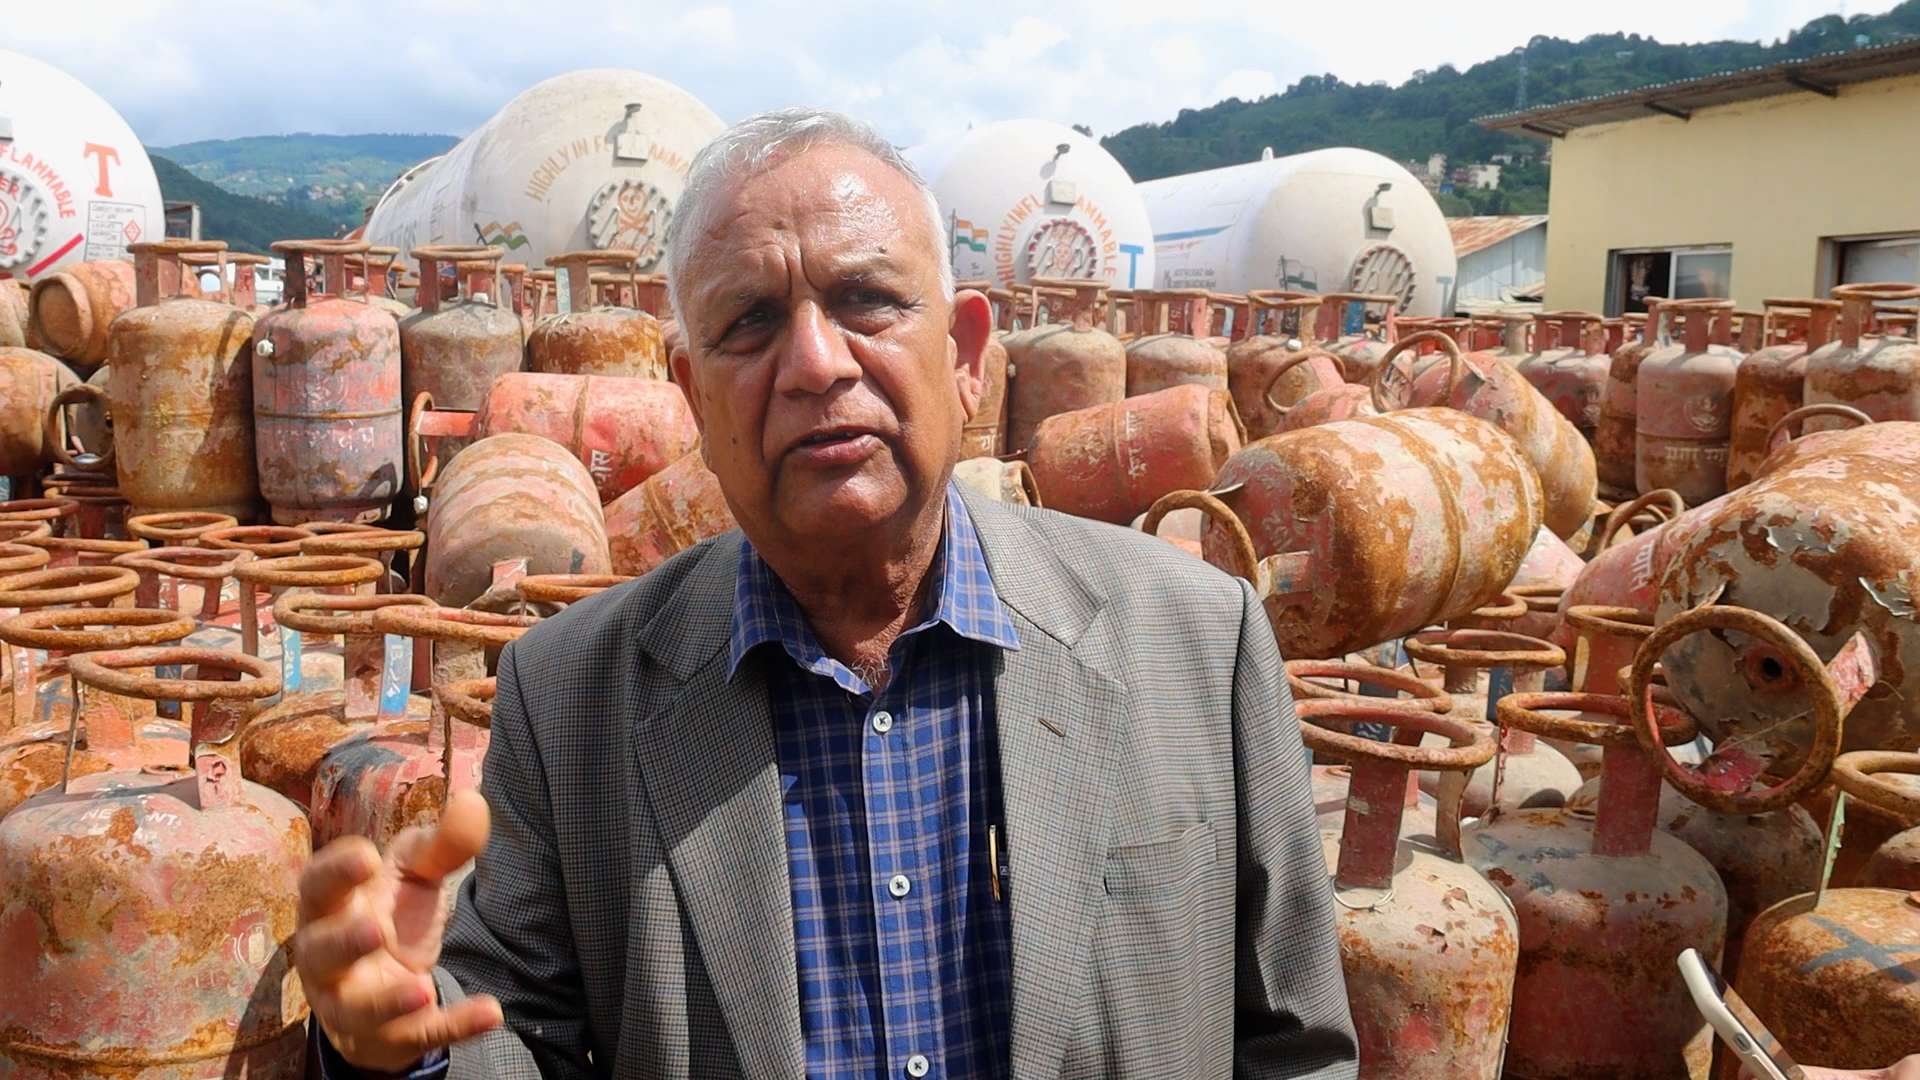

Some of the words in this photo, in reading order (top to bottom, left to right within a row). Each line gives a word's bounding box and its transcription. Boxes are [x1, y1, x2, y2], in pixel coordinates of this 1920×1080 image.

[83, 141, 121, 198] T
[525, 146, 571, 202] HIGHLY
[1120, 243, 1144, 289] T
